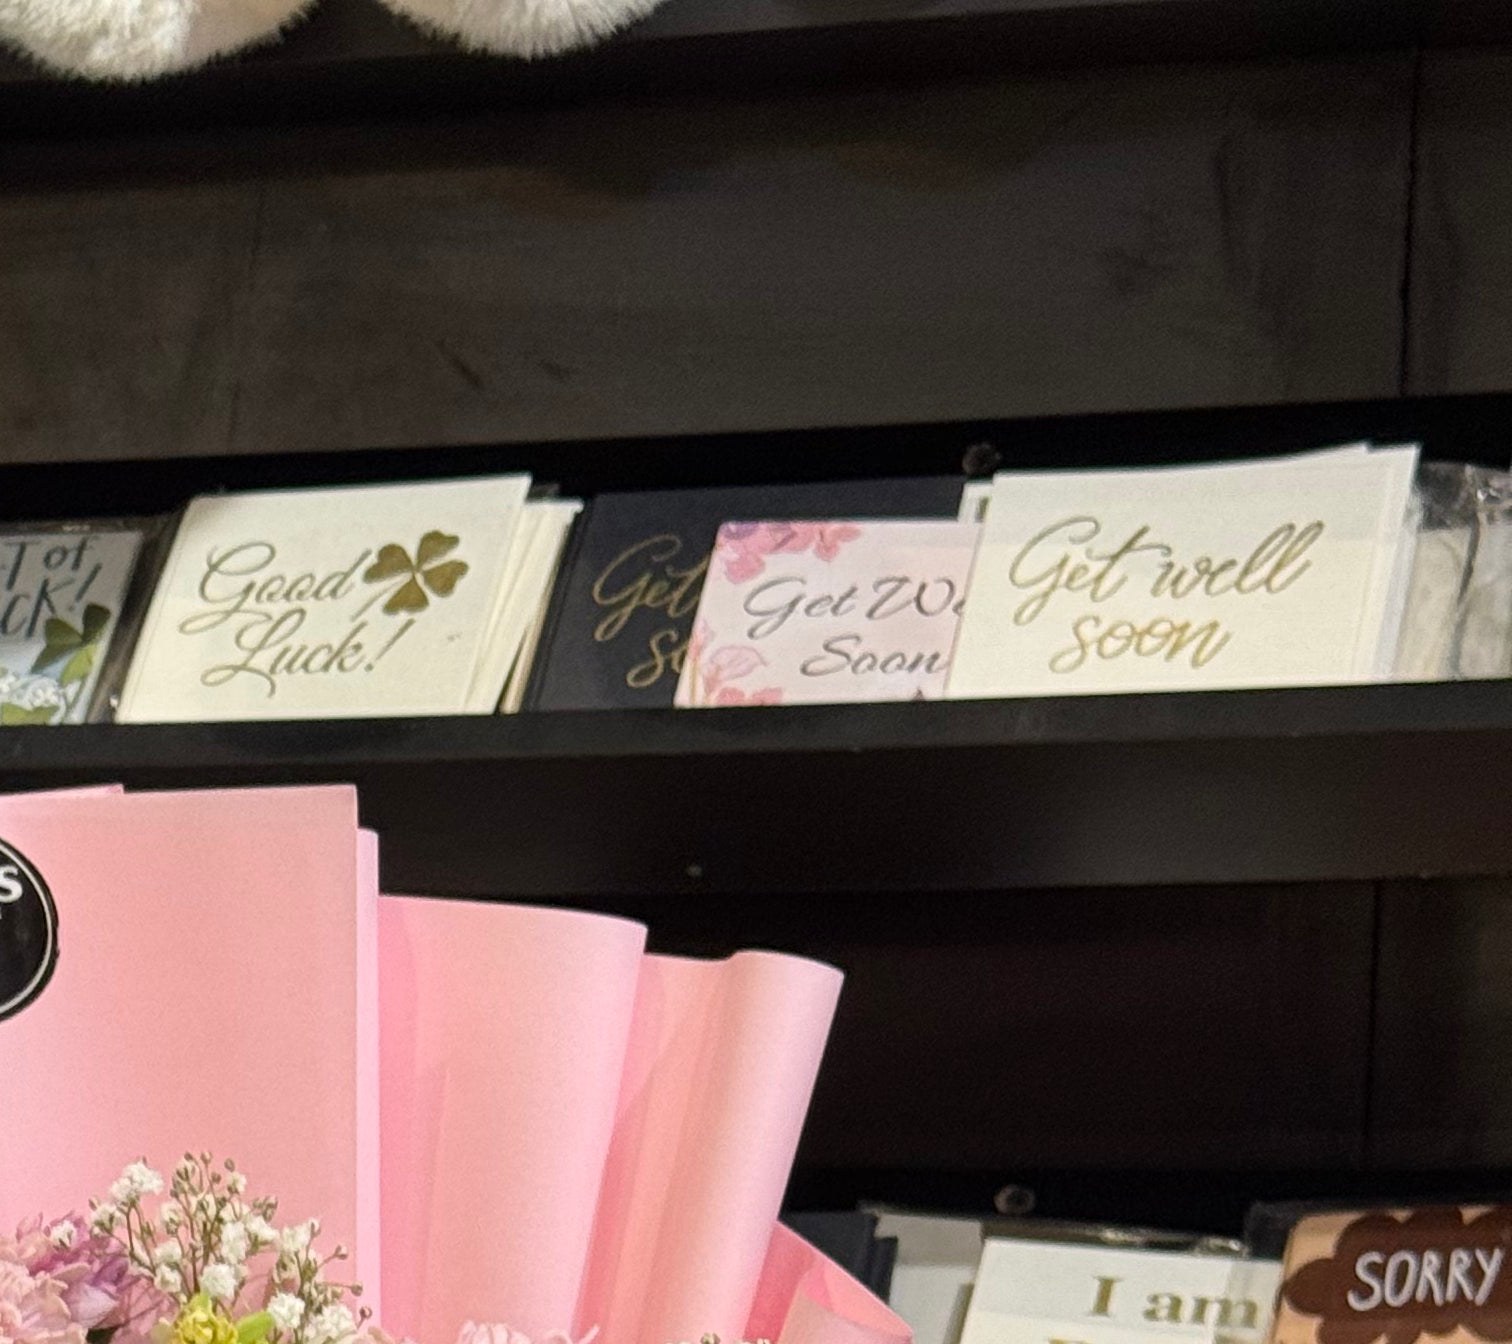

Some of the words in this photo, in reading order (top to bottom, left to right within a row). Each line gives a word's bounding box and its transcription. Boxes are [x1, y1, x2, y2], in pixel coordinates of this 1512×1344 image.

[180, 541, 373, 634] Good
[1009, 516, 1172, 626] Get
[1151, 520, 1324, 599] well
[743, 576, 857, 640] Get
[201, 609, 415, 698] Luck!
[800, 634, 945, 678] Soon
[1049, 615, 1233, 673] soon
[1088, 1275, 1123, 1318] I
[1142, 1291, 1259, 1329] am
[1347, 1247, 1503, 1312] SORRY
